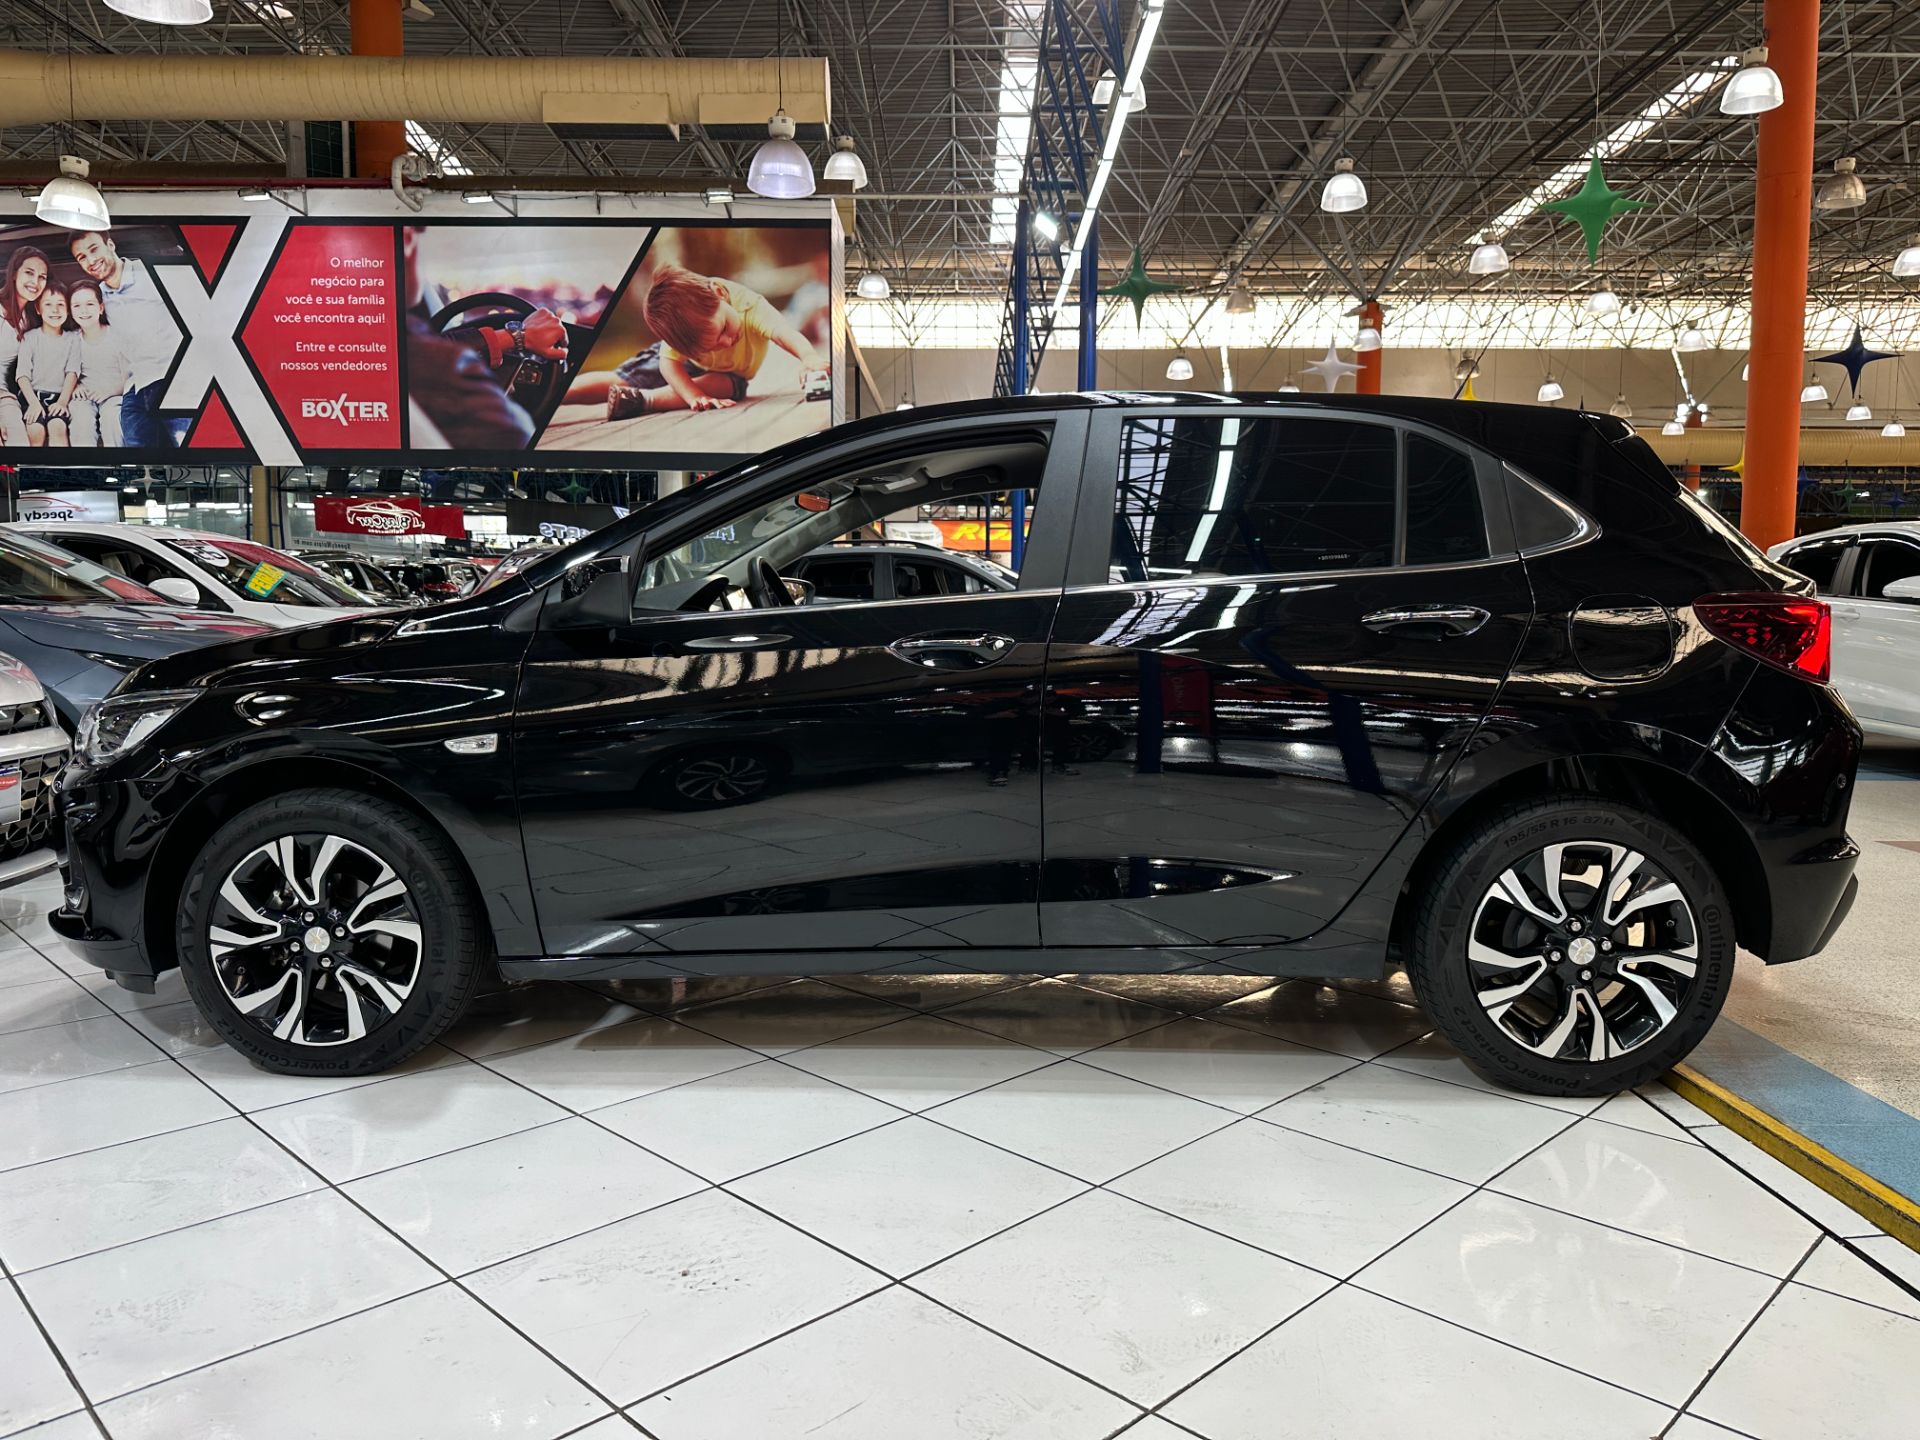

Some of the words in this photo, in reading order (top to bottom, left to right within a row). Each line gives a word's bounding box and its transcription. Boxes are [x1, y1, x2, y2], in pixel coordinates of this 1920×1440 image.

[330, 257, 341, 268] O
[344, 256, 384, 268] melhor
[311, 276, 356, 288] negócio
[360, 278, 384, 288] para
[286, 294, 312, 305] você
[316, 296, 322, 305] e
[326, 296, 344, 305] sua
[348, 294, 385, 305] família
[274, 312, 300, 324] você
[304, 314, 354, 324] encontra
[358, 313, 386, 326] aqui!
[296, 342, 326, 352] Entre
[328, 344, 336, 352] e
[338, 342, 386, 352] consulte
[280, 362, 319, 370] nossos
[322, 360, 388, 371] vendedores
[302, 393, 389, 426] BOXTER
[1504, 822, 1547, 848] 195/55
[1550, 819, 1560, 828] R
[1563, 816, 1578, 826] 16
[1698, 904, 1726, 1009] Continental
[226, 1030, 350, 1070] PowerContact
[1460, 1019, 1580, 1090] PowerContact
